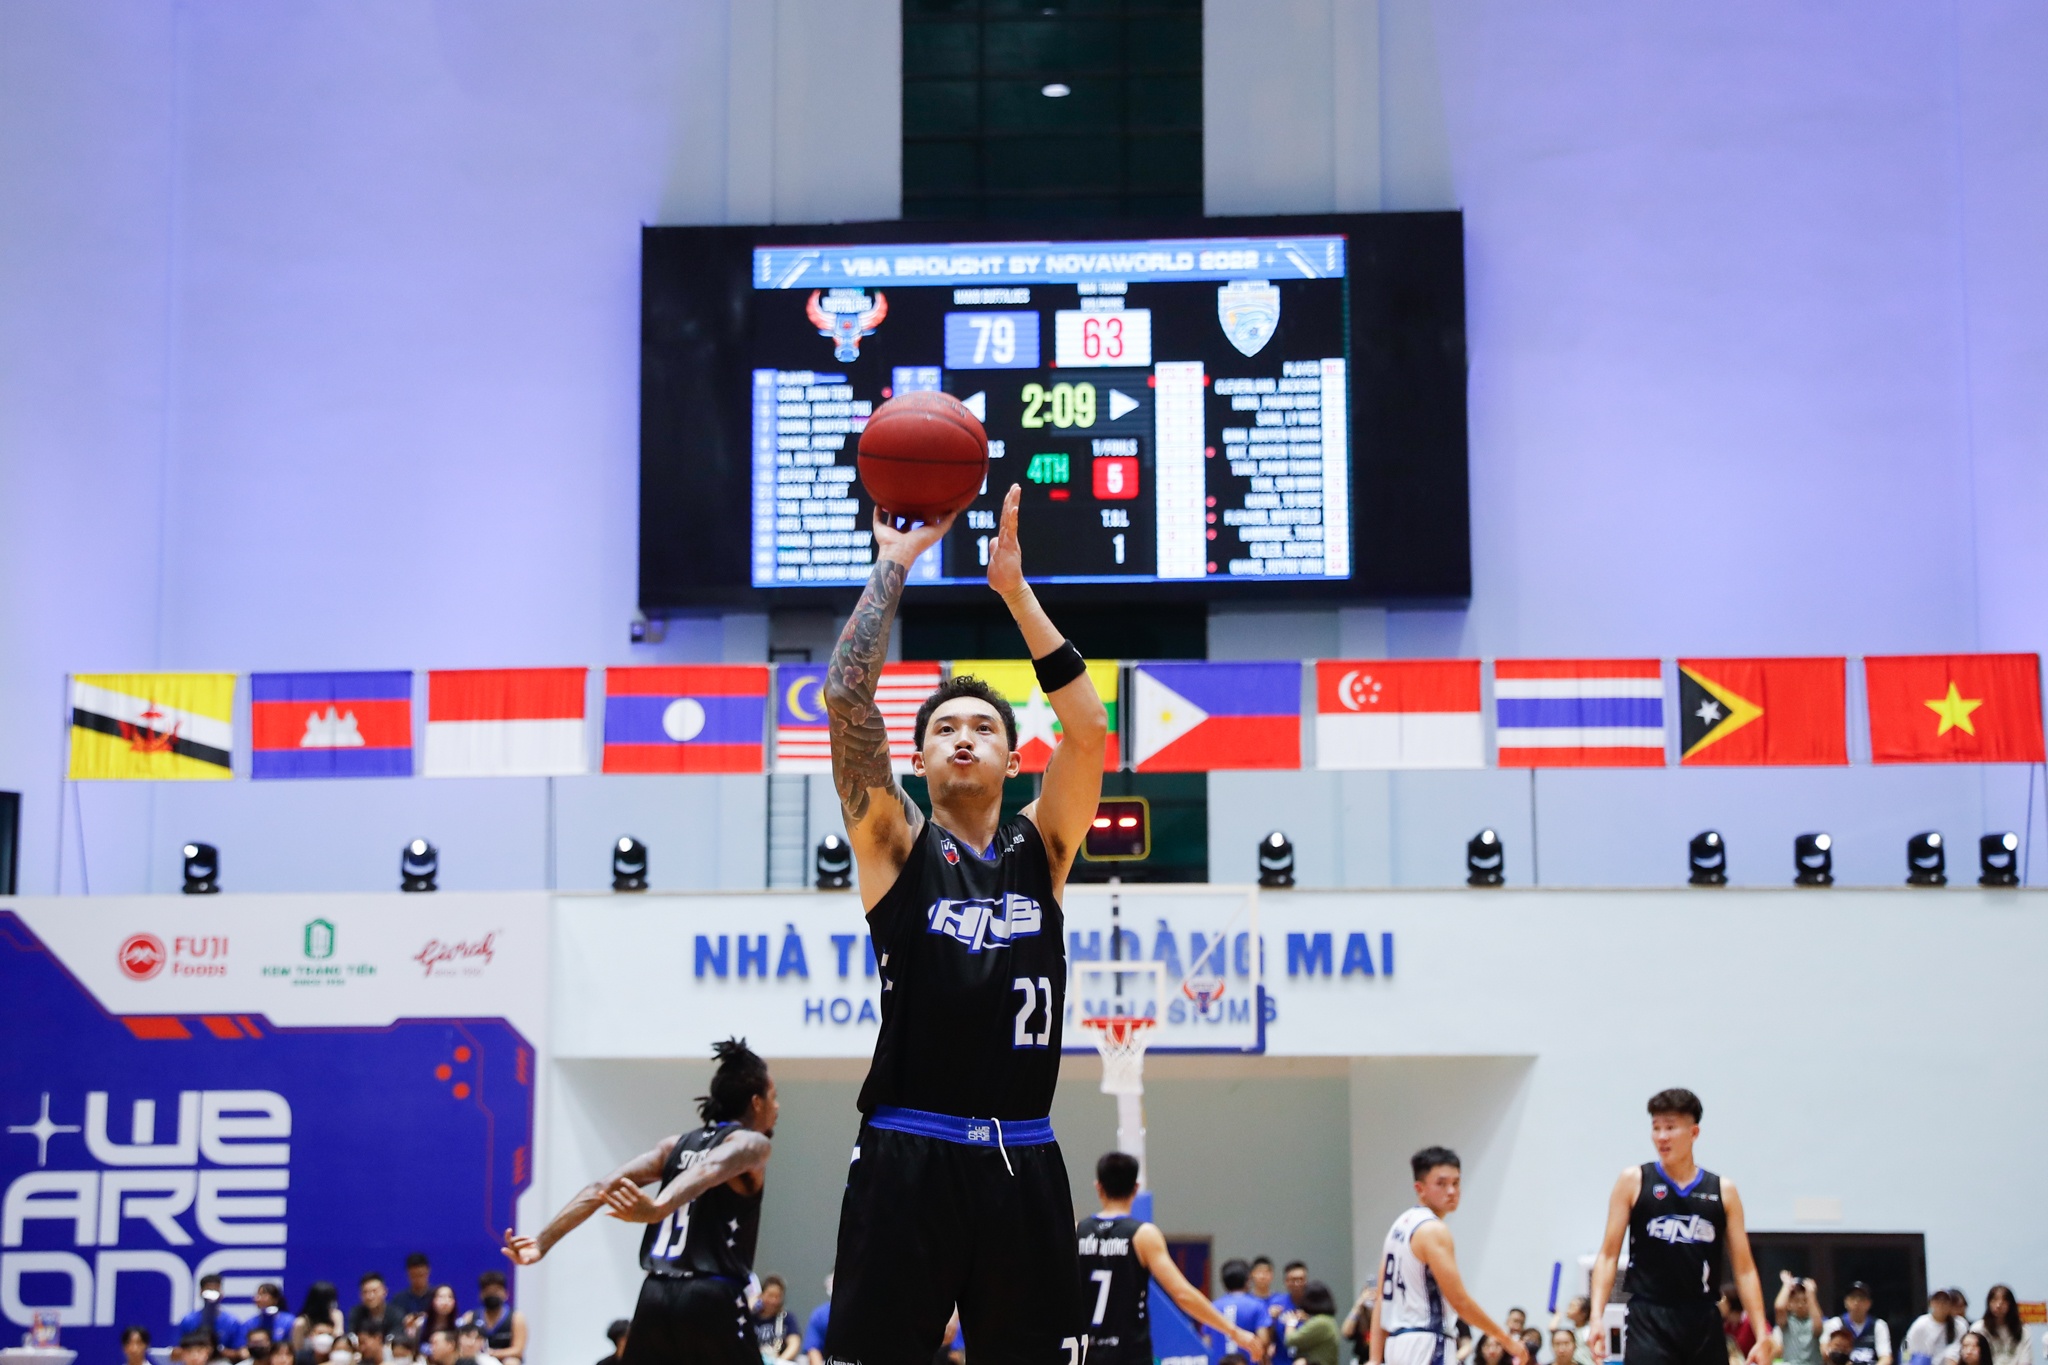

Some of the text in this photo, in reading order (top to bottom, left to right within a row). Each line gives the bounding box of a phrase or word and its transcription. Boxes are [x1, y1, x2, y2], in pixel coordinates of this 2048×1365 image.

[841, 256, 891, 277] VBA
[894, 256, 1010, 276] BROUGHT
[1014, 256, 1041, 275] BY
[1045, 252, 1195, 274] NOVAWORLD
[968, 316, 1016, 364] 79
[1083, 318, 1123, 358] 63
[1021, 382, 1096, 428] 2:09
[1027, 453, 1070, 484] 4TH
[1112, 533, 1125, 564] 1
[174, 936, 230, 960] FUJI
[693, 923, 810, 978] NHÀ
[1286, 932, 1394, 976] MAI
[1, 1169, 290, 1247] ARE
[1091, 1268, 1113, 1327] 7
